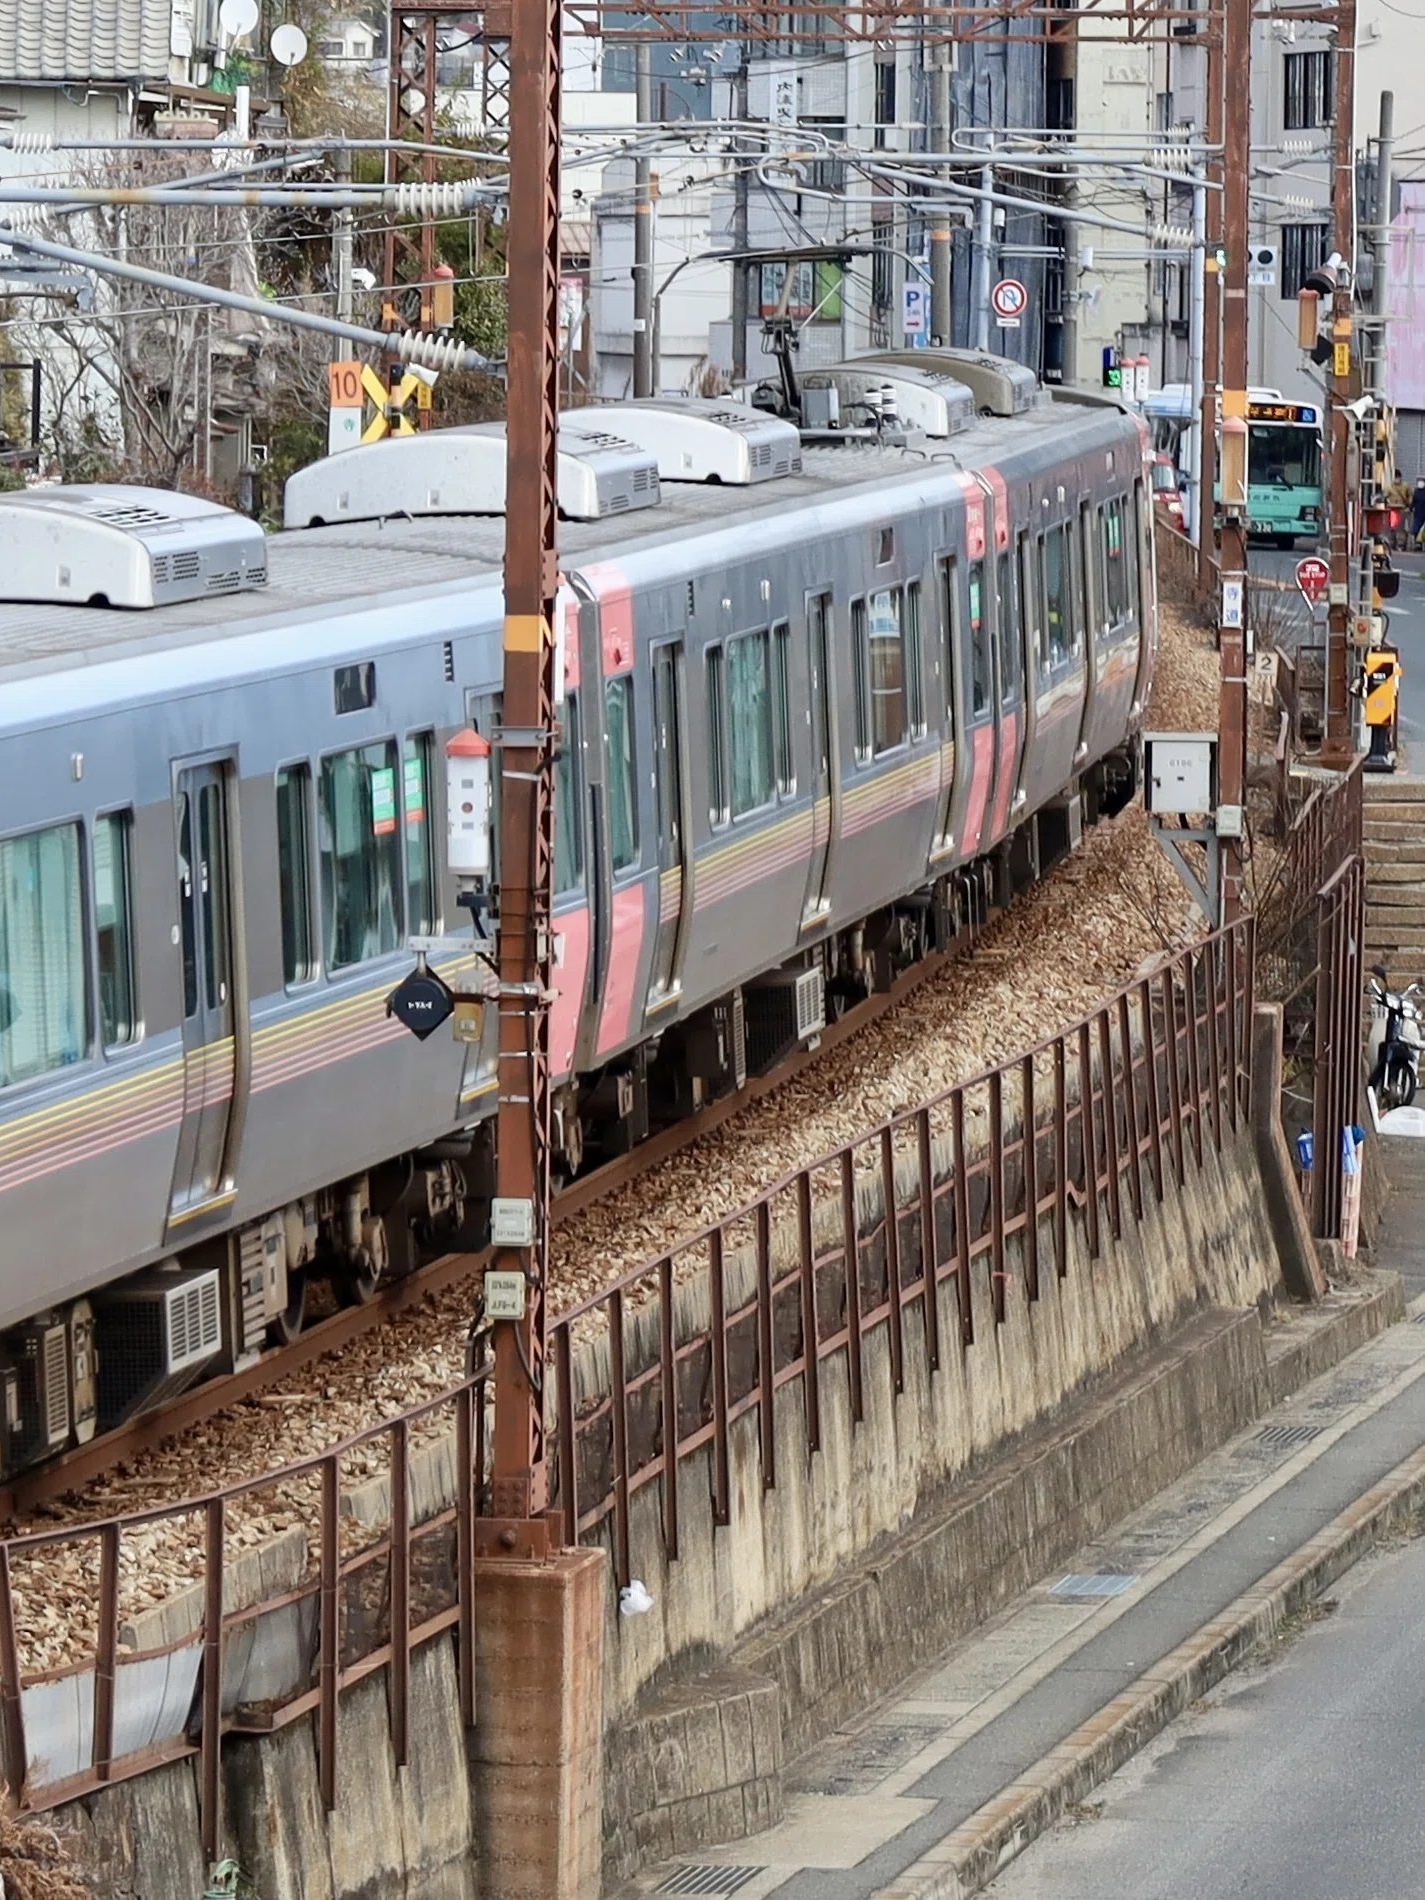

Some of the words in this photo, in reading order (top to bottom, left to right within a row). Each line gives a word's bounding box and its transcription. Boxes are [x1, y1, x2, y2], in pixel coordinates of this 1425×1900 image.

[906, 290, 920, 308] P
[332, 370, 358, 400] 10
[1261, 655, 1272, 670] 2
